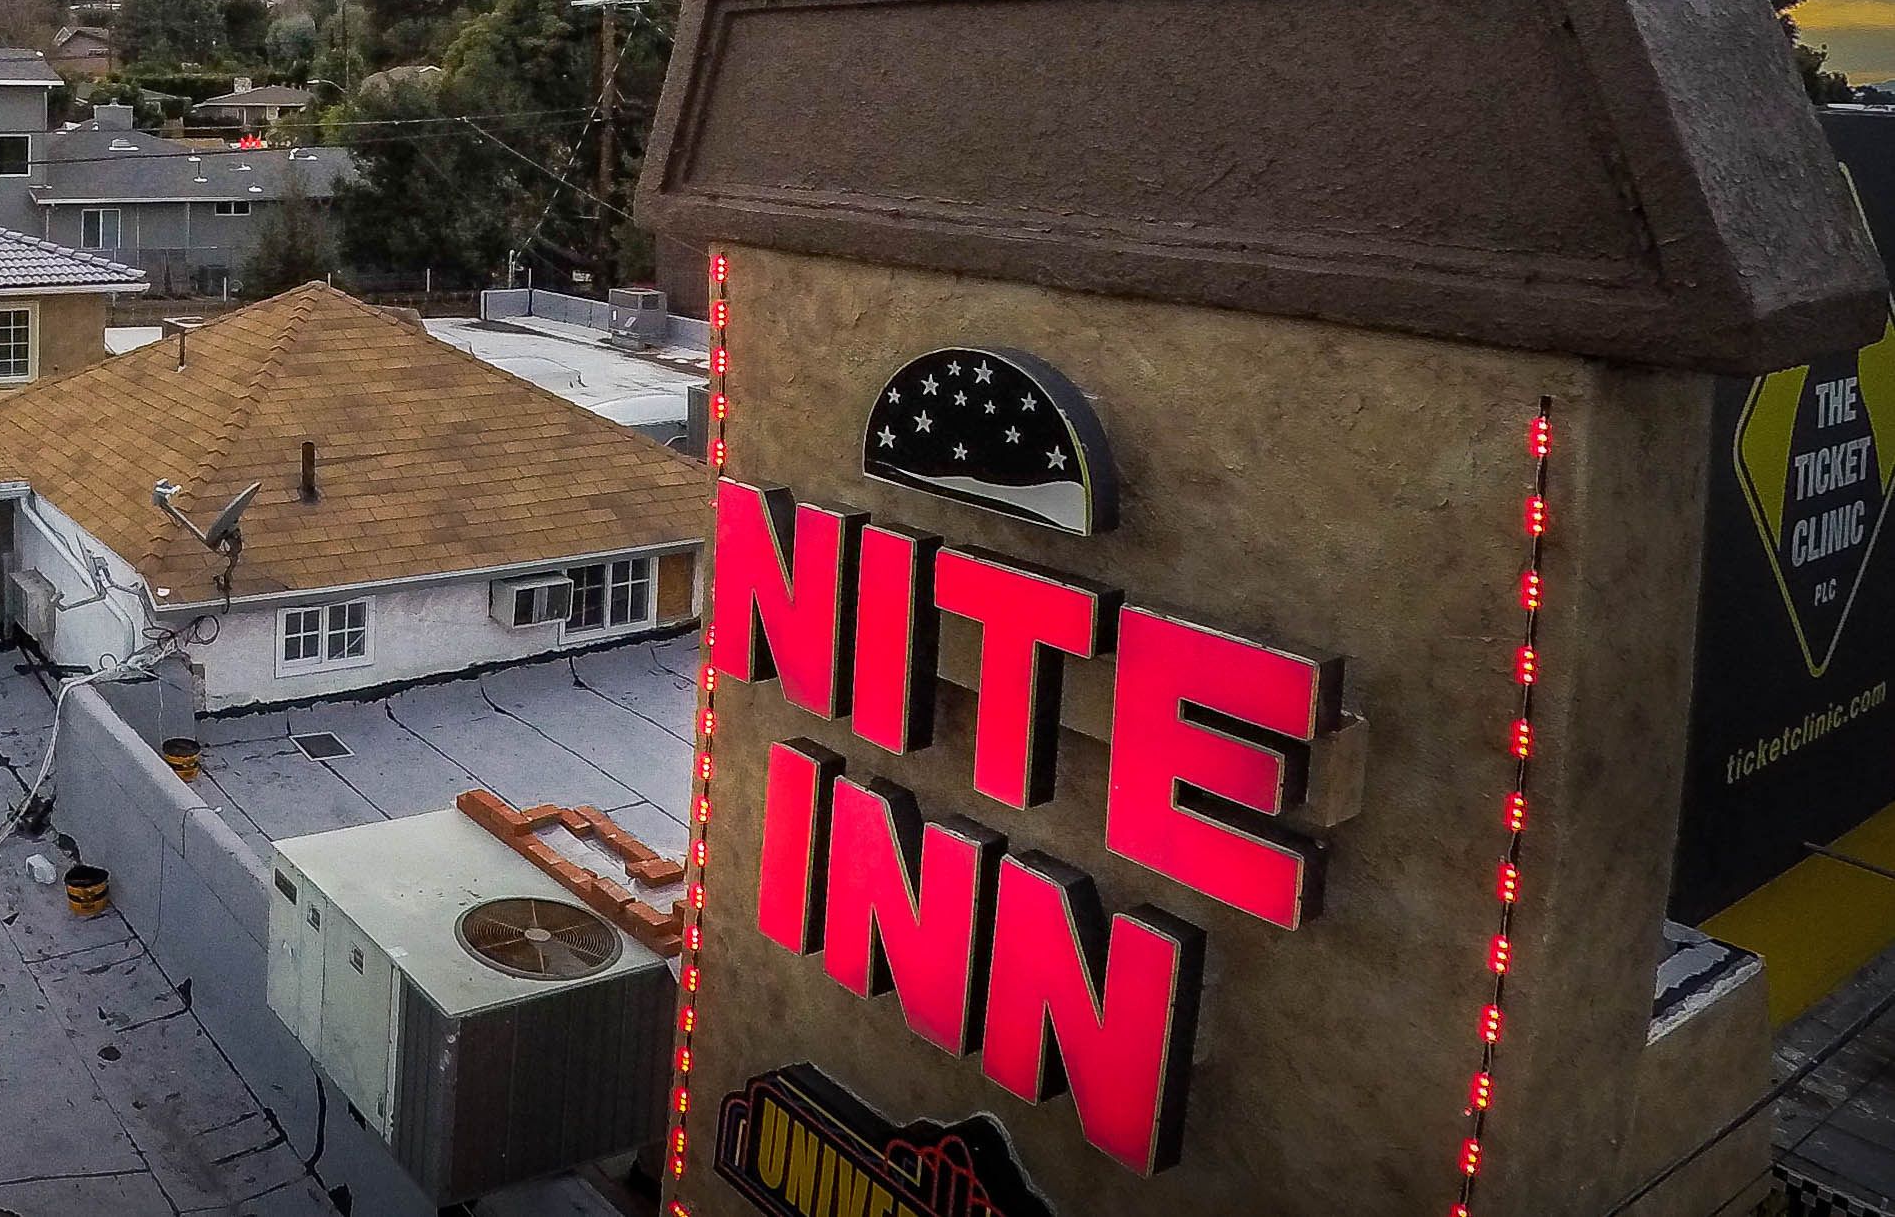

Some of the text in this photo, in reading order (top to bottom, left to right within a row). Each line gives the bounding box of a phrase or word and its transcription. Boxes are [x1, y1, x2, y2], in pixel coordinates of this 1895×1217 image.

[1815, 376, 1857, 428] THE
[1794, 436, 1871, 501] TICKET
[1791, 500, 1866, 567] CLINIC
[1814, 578, 1837, 606] PLC
[713, 475, 1320, 931] NITE
[1726, 681, 1887, 784] ticketclinic.com
[758, 739, 1182, 1177] INN
[757, 1096, 919, 1217] UNIV
